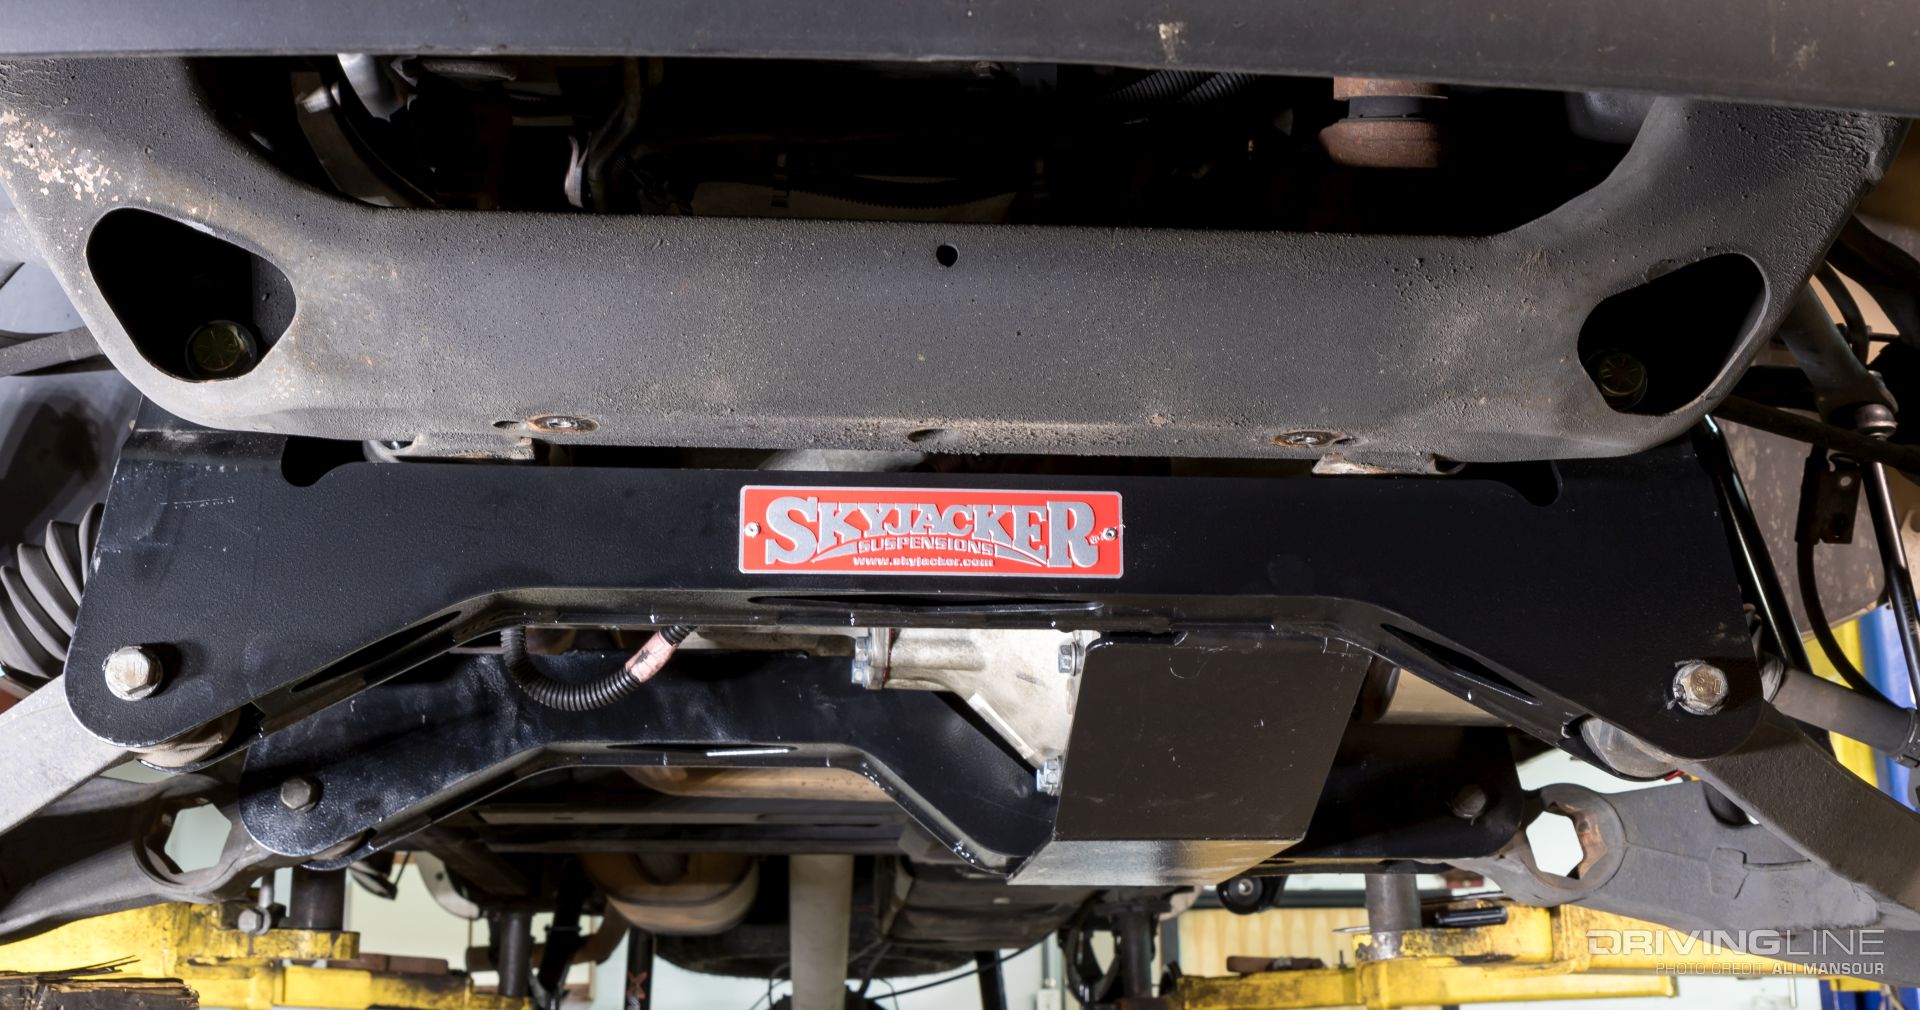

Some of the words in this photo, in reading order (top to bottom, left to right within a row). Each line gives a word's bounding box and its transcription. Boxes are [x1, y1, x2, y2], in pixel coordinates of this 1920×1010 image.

[765, 496, 1099, 568] SKYJACKER
[858, 536, 994, 557] SUSPENSIONS
[853, 556, 994, 567] www.skyjacker.com
